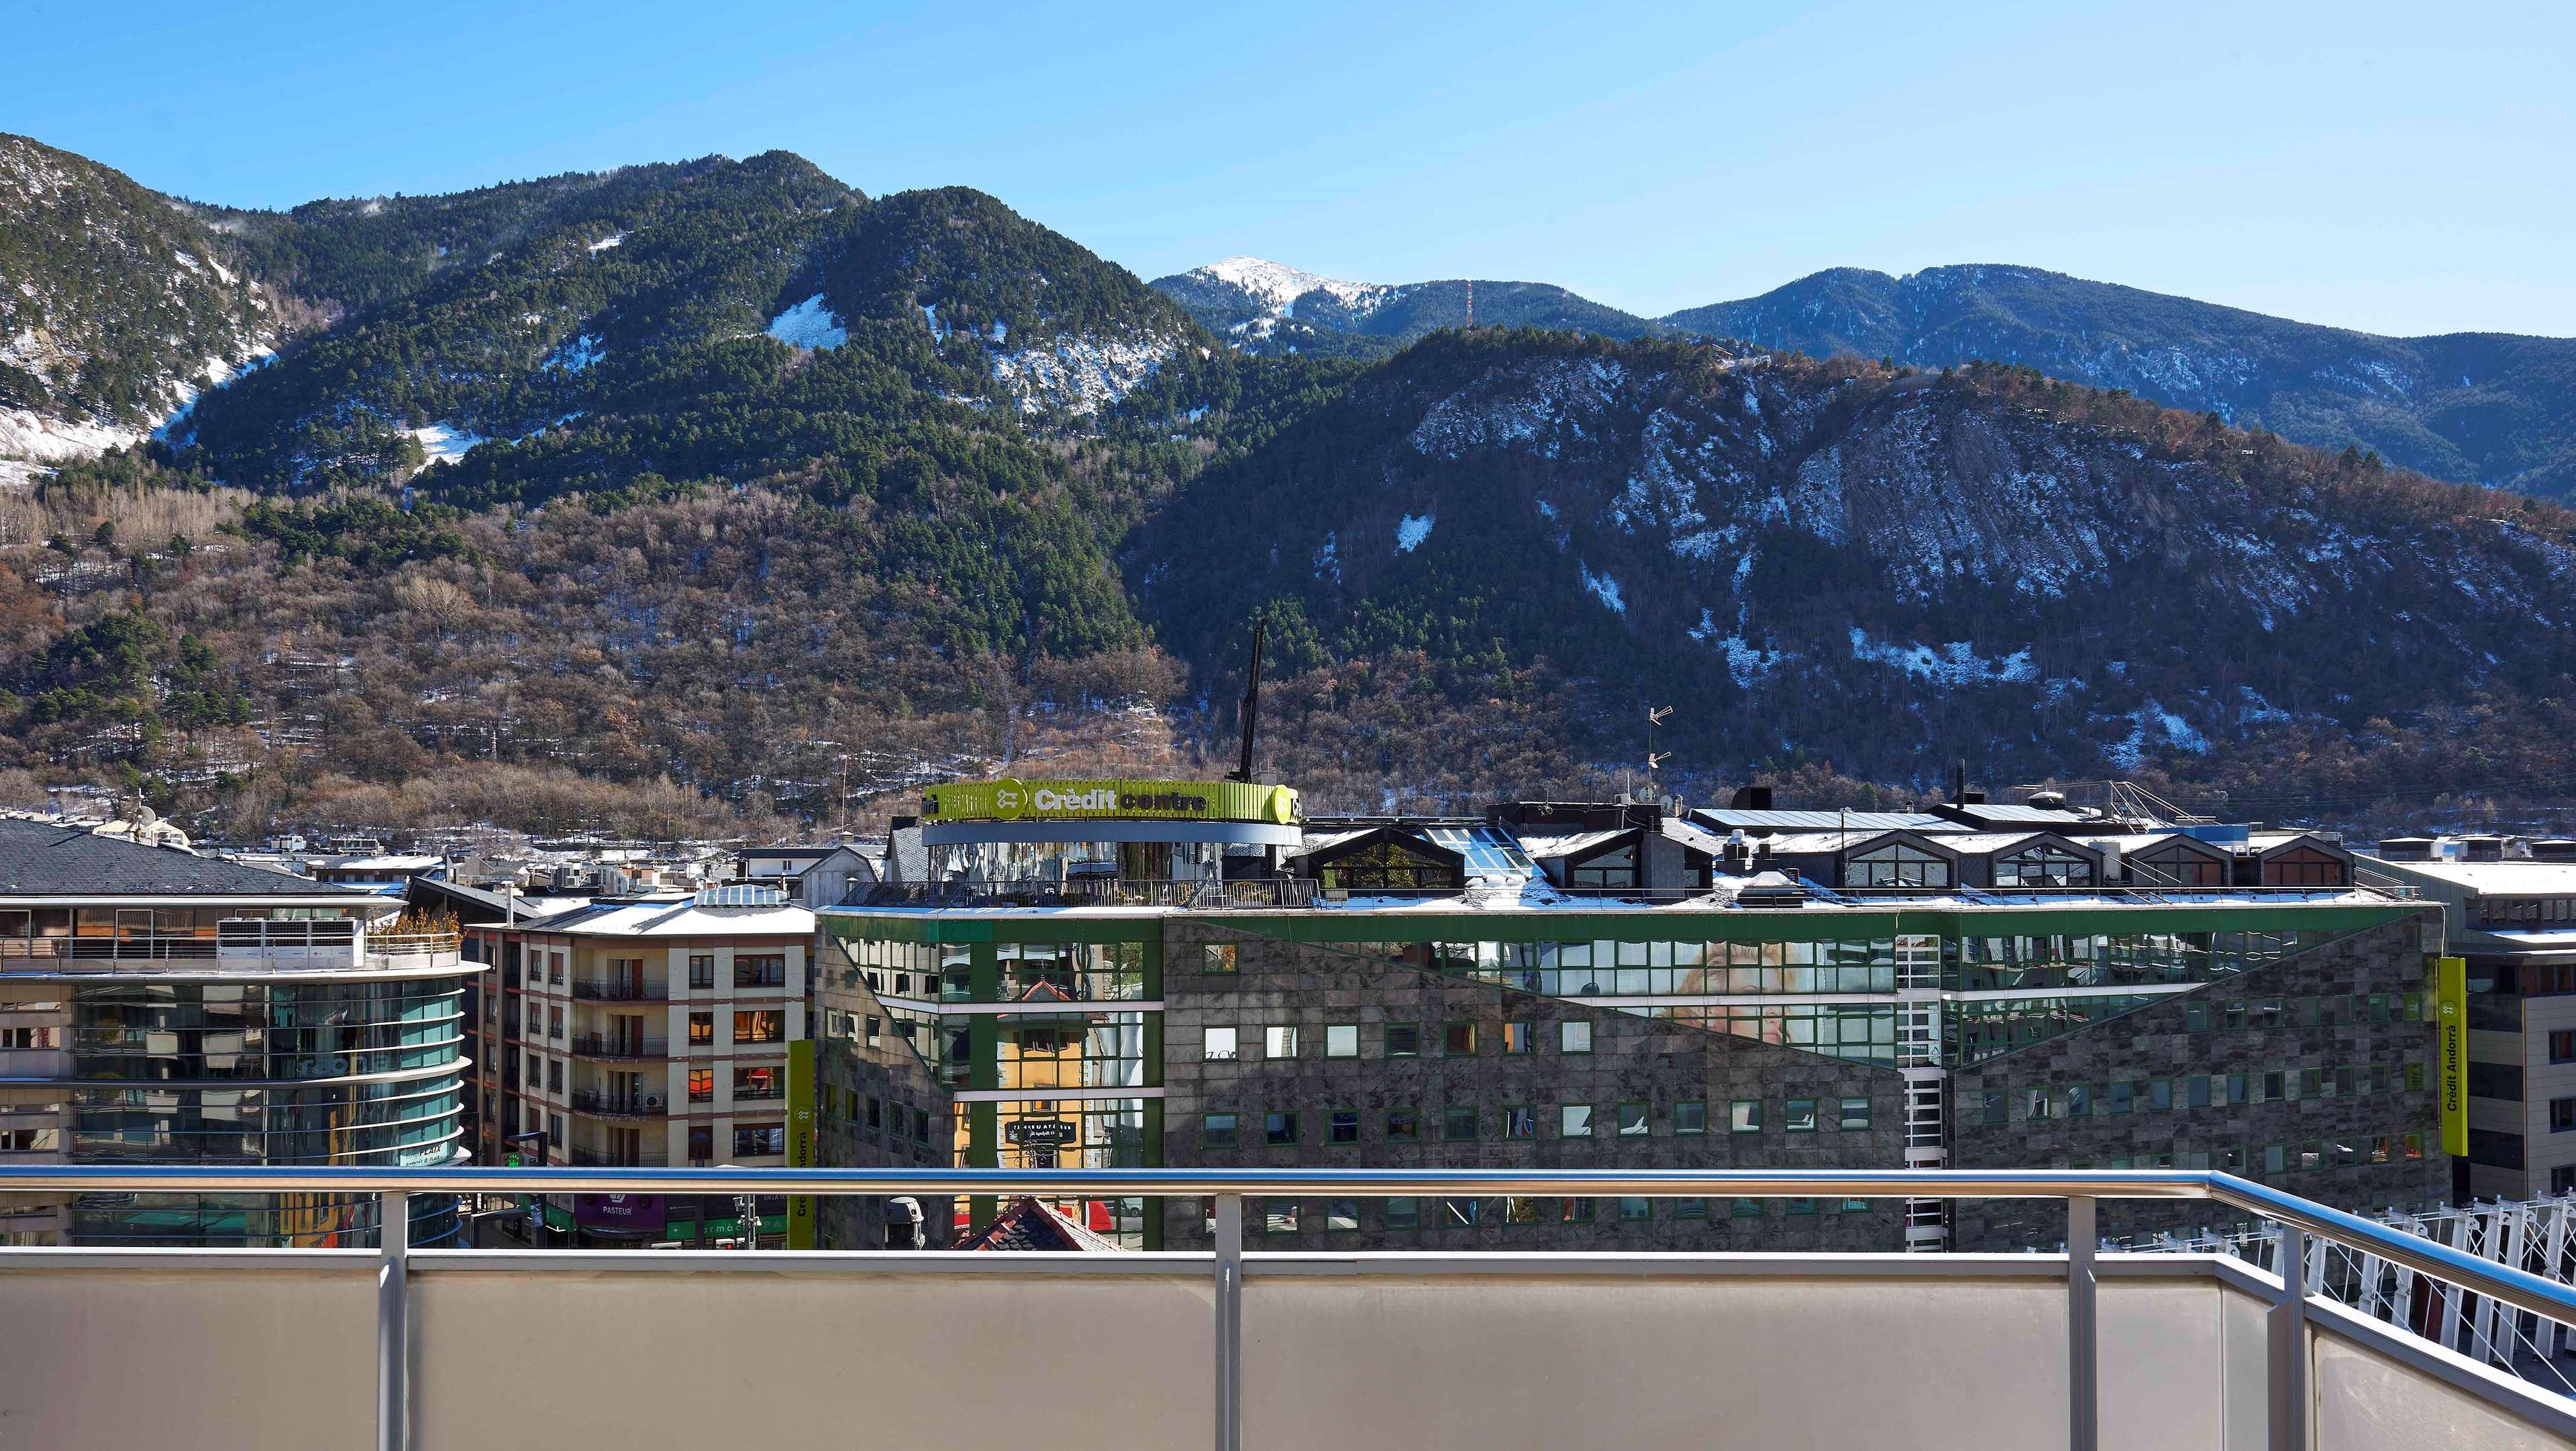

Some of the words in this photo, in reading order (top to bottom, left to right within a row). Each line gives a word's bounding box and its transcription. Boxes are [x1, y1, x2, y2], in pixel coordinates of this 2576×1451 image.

[1035, 789, 1117, 810] Crèdit
[1121, 792, 1207, 811] centre
[2446, 1025, 2456, 1072] Andorrà
[2446, 1075, 2457, 1112] Crèdit
[419, 1145, 442, 1157] FLAIX
[603, 1207, 631, 1215] PASTEUR
